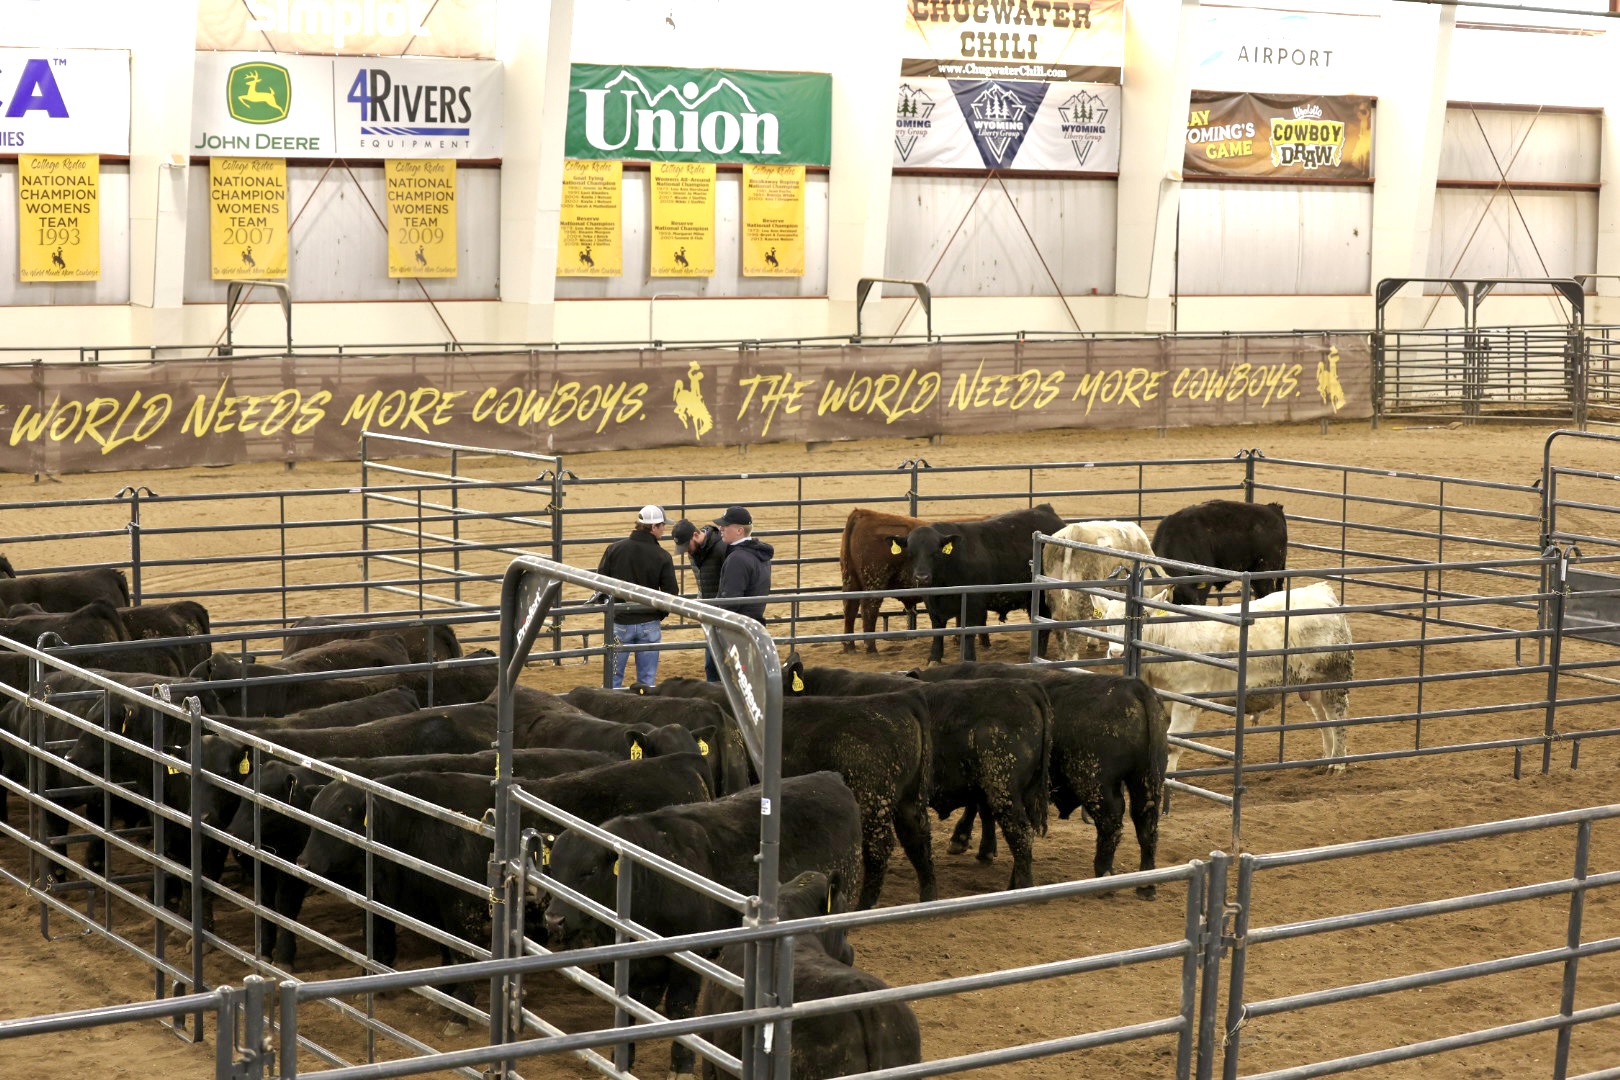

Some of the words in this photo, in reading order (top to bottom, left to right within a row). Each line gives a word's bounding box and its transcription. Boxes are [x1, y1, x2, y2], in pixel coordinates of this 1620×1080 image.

[912, 0, 1092, 29] CHUGWATER
[960, 31, 1037, 59] CHILI
[1238, 46, 1333, 67] AIRPORT
[938, 63, 1067, 78] www.ChugwaterChili.com
[0, 59, 70, 118] A
[579, 81, 781, 155] Union
[974, 120, 1024, 130] WYOMING
[1187, 110, 1211, 127] AY
[908, 128, 928, 137] Group
[978, 129, 999, 139] Liberty
[1000, 130, 1020, 139] Group
[1061, 124, 1106, 133] WYOMING
[1186, 122, 1256, 144] OMING'S
[1273, 124, 1342, 142] COWBOY
[0, 132, 24, 146] IES
[195, 132, 250, 150] JOHN
[256, 133, 320, 150] DEERE
[361, 139, 470, 148] EQUIPMENT
[1064, 132, 1084, 140] Liberty
[1085, 133, 1102, 142] Group
[1206, 140, 1253, 159] GAME
[1281, 143, 1332, 167] DRAW
[31, 158, 59, 173] College
[222, 160, 248, 174] College
[395, 162, 421, 176] College
[22, 175, 94, 186] NATIONAL
[213, 176, 282, 187] NATIONAL
[388, 178, 452, 188] NATIONAL
[20, 189, 96, 200] CHAMPION
[211, 190, 285, 200] CHAMPION
[388, 191, 454, 201] CHAMPION
[26, 203, 91, 214] WOMENS
[217, 203, 279, 214] WOMENS
[393, 204, 448, 214] WOMENS
[39, 217, 78, 228] TEAM
[230, 217, 267, 227] TEAM
[404, 217, 438, 227] TEAM
[38, 228, 80, 246] 1993
[223, 228, 273, 245] 2007
[399, 228, 444, 244] 2009
[737, 372, 815, 437] THE
[817, 369, 941, 424] WORLD
[948, 357, 1065, 411] NEEDS
[1072, 368, 1170, 416] MORE
[1172, 361, 1304, 408] COWBOYS.
[9, 390, 172, 455] WORLD
[181, 375, 333, 438] NEEDS
[341, 387, 468, 442] MORE
[472, 380, 649, 434] COWBOYS.
[632, 752, 641, 760] 12
